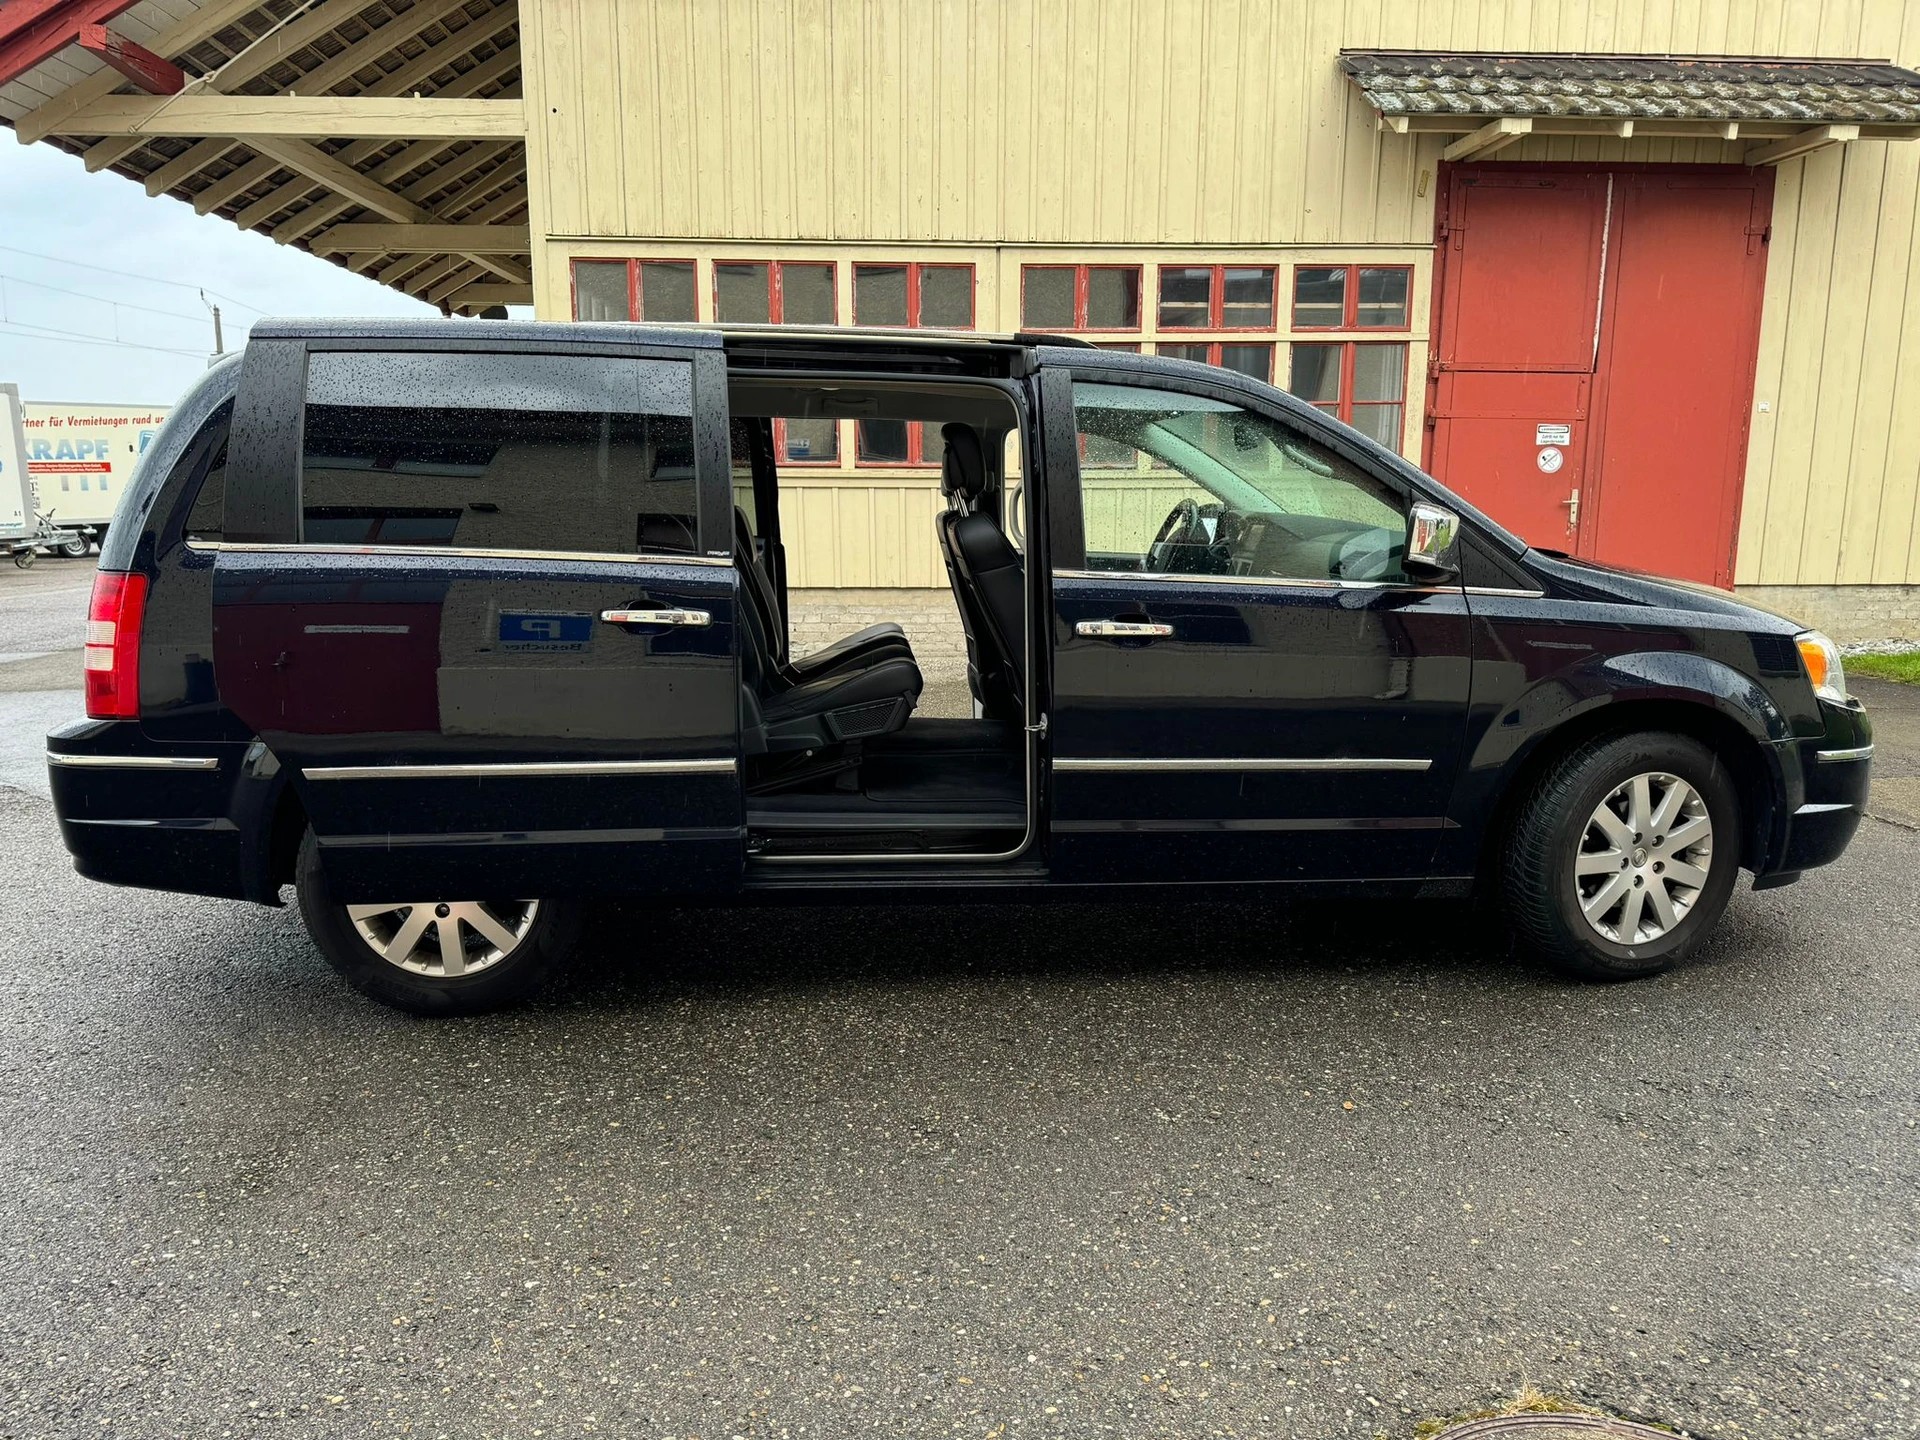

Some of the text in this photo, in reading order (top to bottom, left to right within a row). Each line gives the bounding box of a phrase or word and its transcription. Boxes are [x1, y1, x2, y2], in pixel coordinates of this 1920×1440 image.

[49, 416, 63, 427] für
[67, 415, 129, 428] Vermietungen
[132, 414, 151, 424] rund
